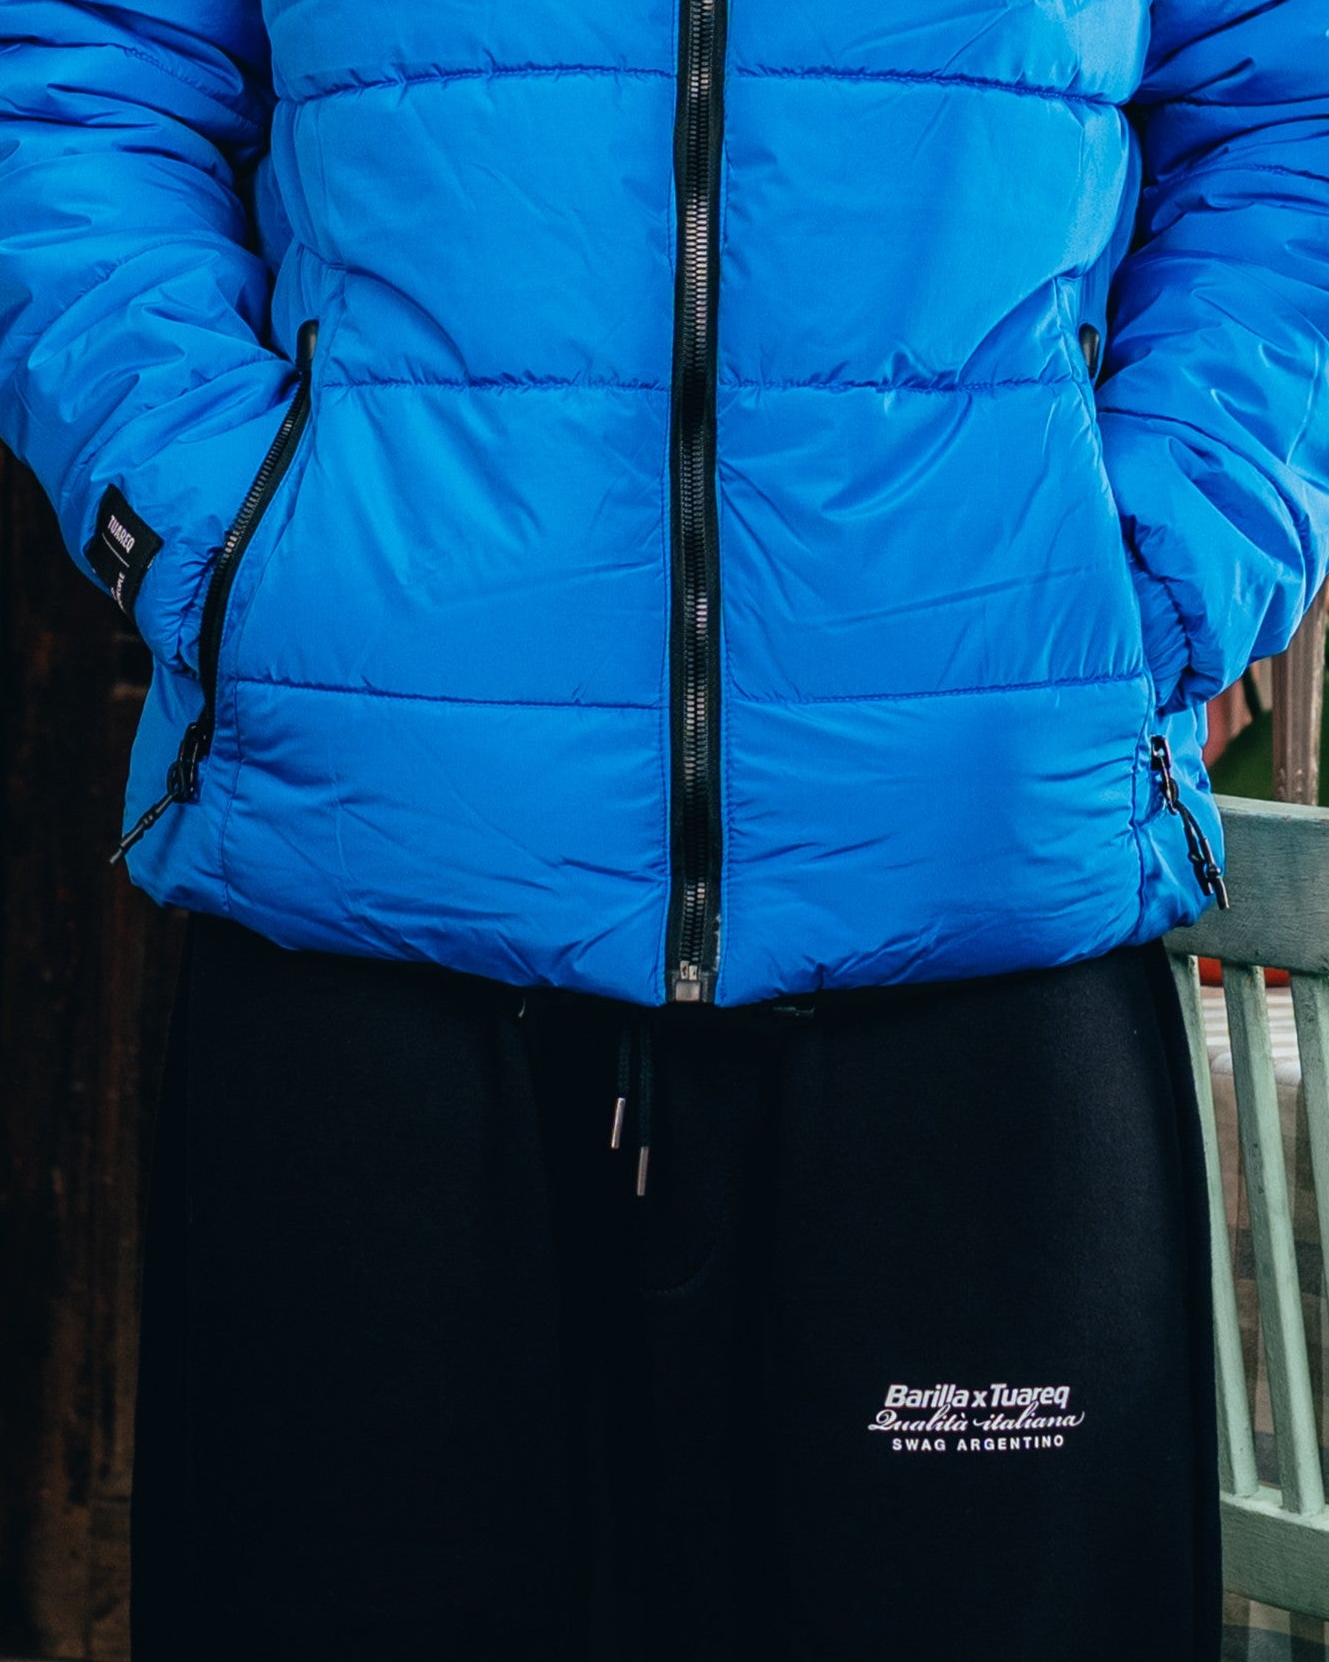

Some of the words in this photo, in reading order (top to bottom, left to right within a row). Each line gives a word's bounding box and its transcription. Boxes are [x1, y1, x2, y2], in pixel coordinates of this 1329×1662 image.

[108, 514, 135, 554] TUAREQ
[884, 1384, 970, 1409] Barilla
[970, 1390, 987, 1408] x
[990, 1383, 1070, 1409] Tuareq
[868, 1403, 968, 1431] Qualità
[973, 1401, 1085, 1431] italiana
[892, 1438, 946, 1452] SWAG
[956, 1435, 1064, 1452] ARGENTINO
